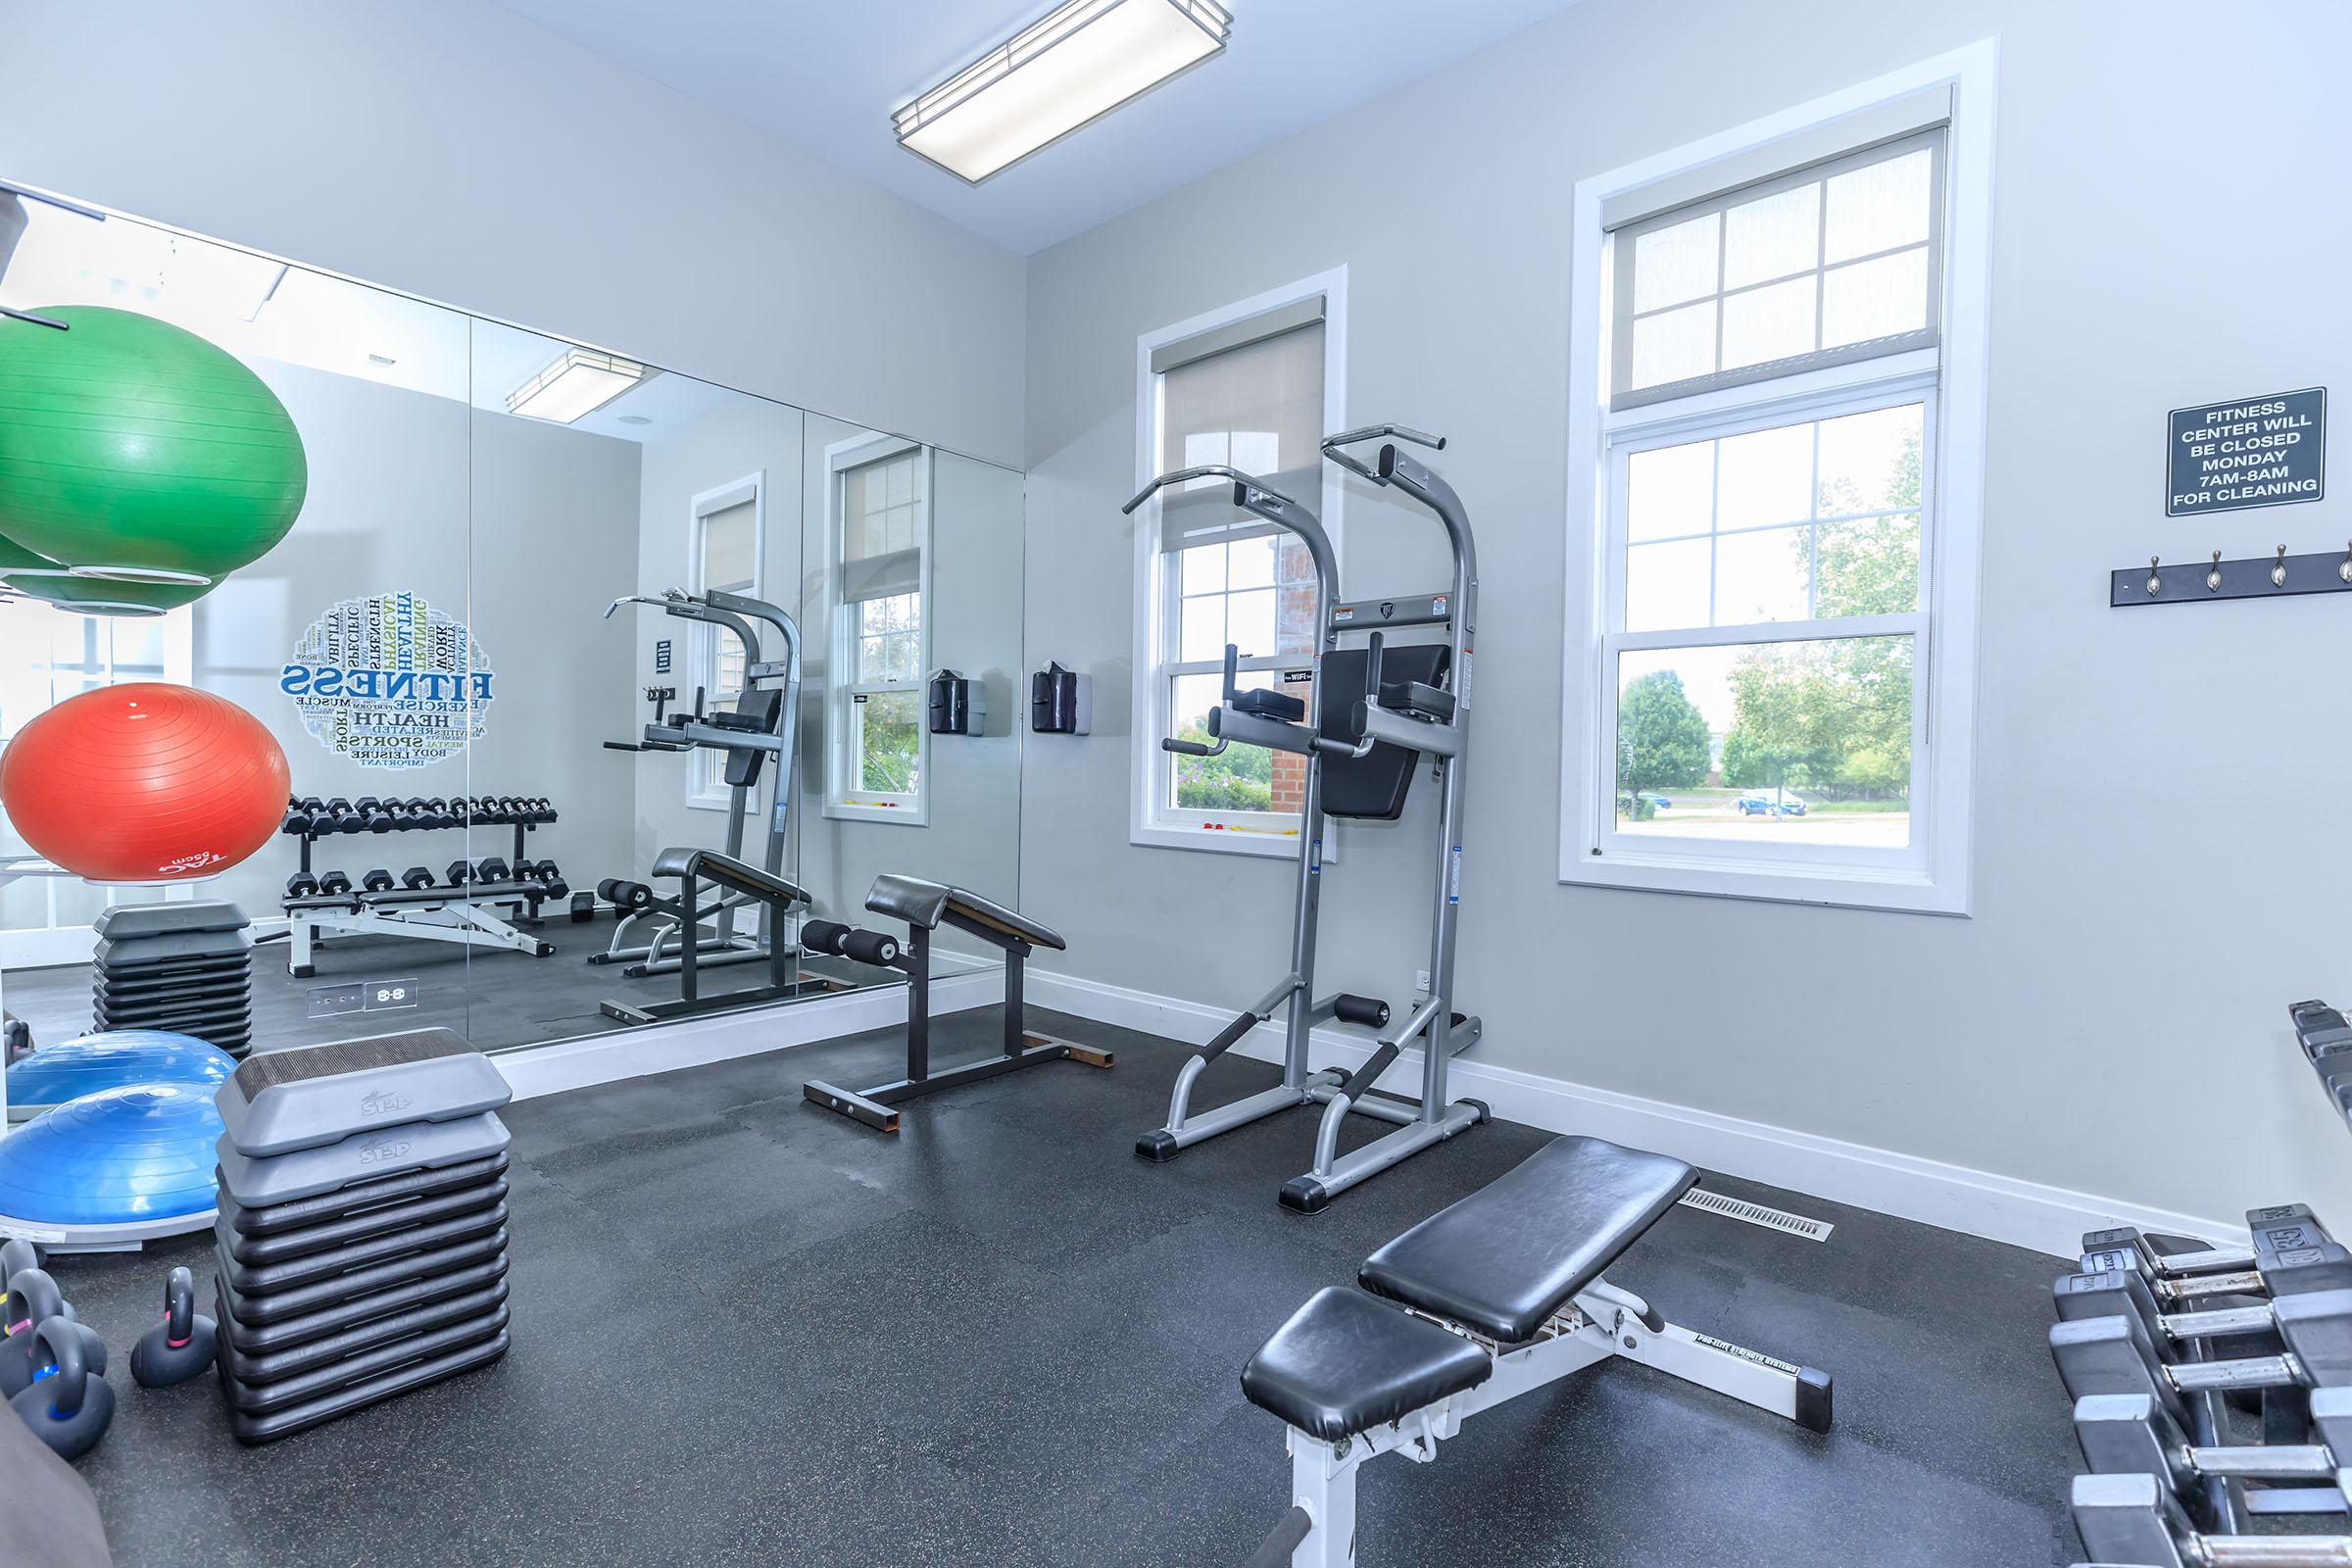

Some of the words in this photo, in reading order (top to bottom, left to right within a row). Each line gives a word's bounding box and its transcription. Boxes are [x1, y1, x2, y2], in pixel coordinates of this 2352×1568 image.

[2206, 402, 2286, 423] FITNESS
[2181, 422, 2258, 443] CENTER
[2264, 415, 2312, 431] WILL
[2190, 444, 2216, 458] BE
[2221, 432, 2301, 454] CLOSED
[2202, 450, 2287, 471] MONDAY
[2199, 466, 2289, 487] 7AM-8AM
[2173, 492, 2211, 506] FOR
[2216, 479, 2318, 502] CLEANING
[172, 851, 210, 864] 55cm
[2273, 1229, 2306, 1249] 35
